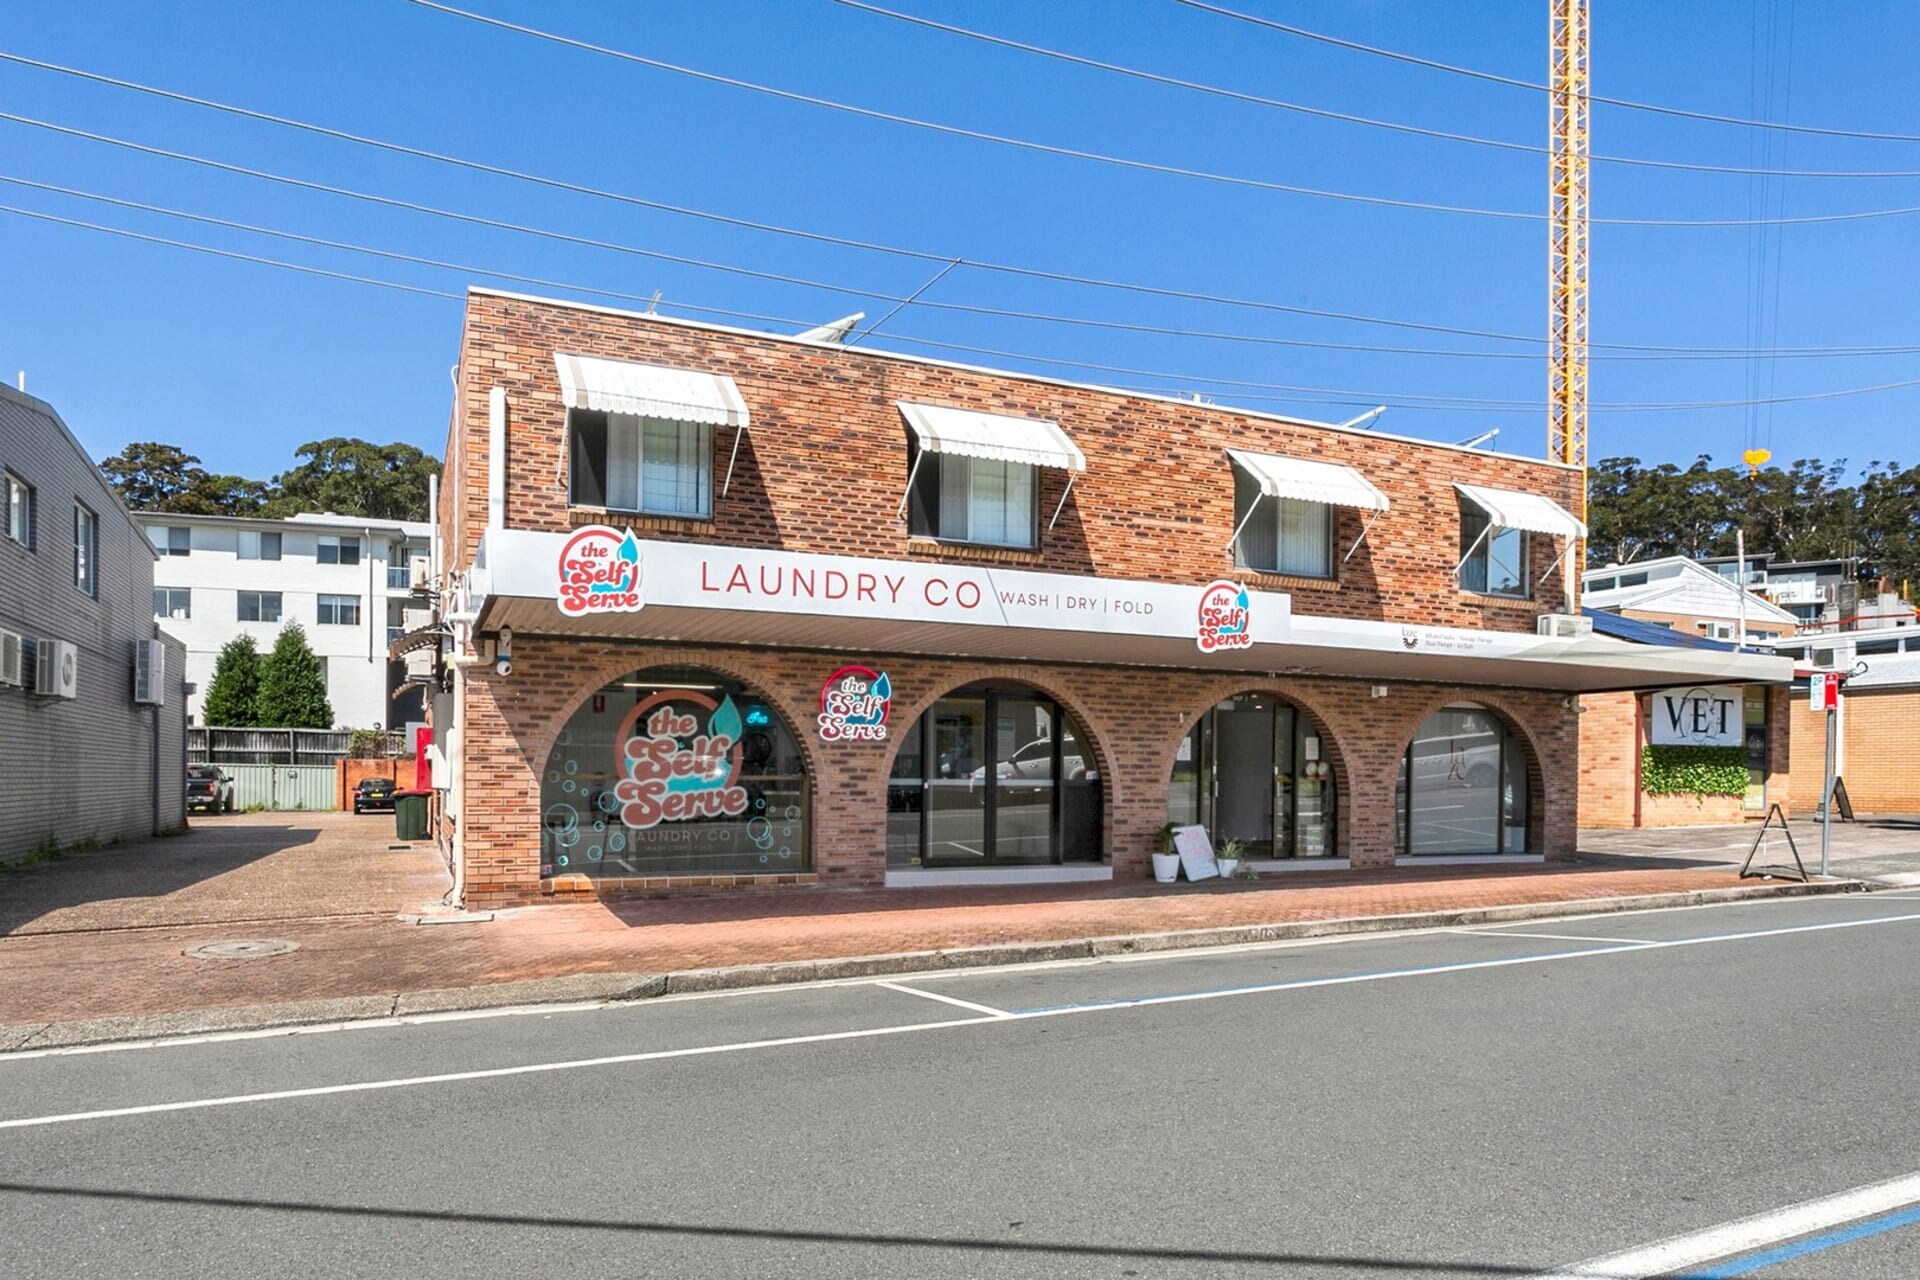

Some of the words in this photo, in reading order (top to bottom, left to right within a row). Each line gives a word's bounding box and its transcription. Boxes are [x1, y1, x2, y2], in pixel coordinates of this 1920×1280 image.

[581, 542, 608, 557] the
[567, 559, 630, 585] Self
[702, 561, 905, 603] LAUNDRY
[924, 578, 980, 609] CO
[560, 584, 639, 611] Serve
[1000, 591, 1049, 607] WASH
[1066, 596, 1097, 610] DRY
[1114, 600, 1154, 615] FOLD
[1212, 593, 1230, 606] the
[1203, 607, 1244, 627] Self
[1199, 627, 1250, 649] Serve
[841, 676, 867, 693] the
[828, 691, 884, 719] Self
[1664, 696, 1734, 734] VET
[648, 706, 698, 738] the
[818, 713, 886, 740] Serve
[625, 736, 731, 782] Self
[614, 778, 748, 829] Serve
[636, 831, 700, 842] AUNDRY
[707, 830, 730, 840] CO
